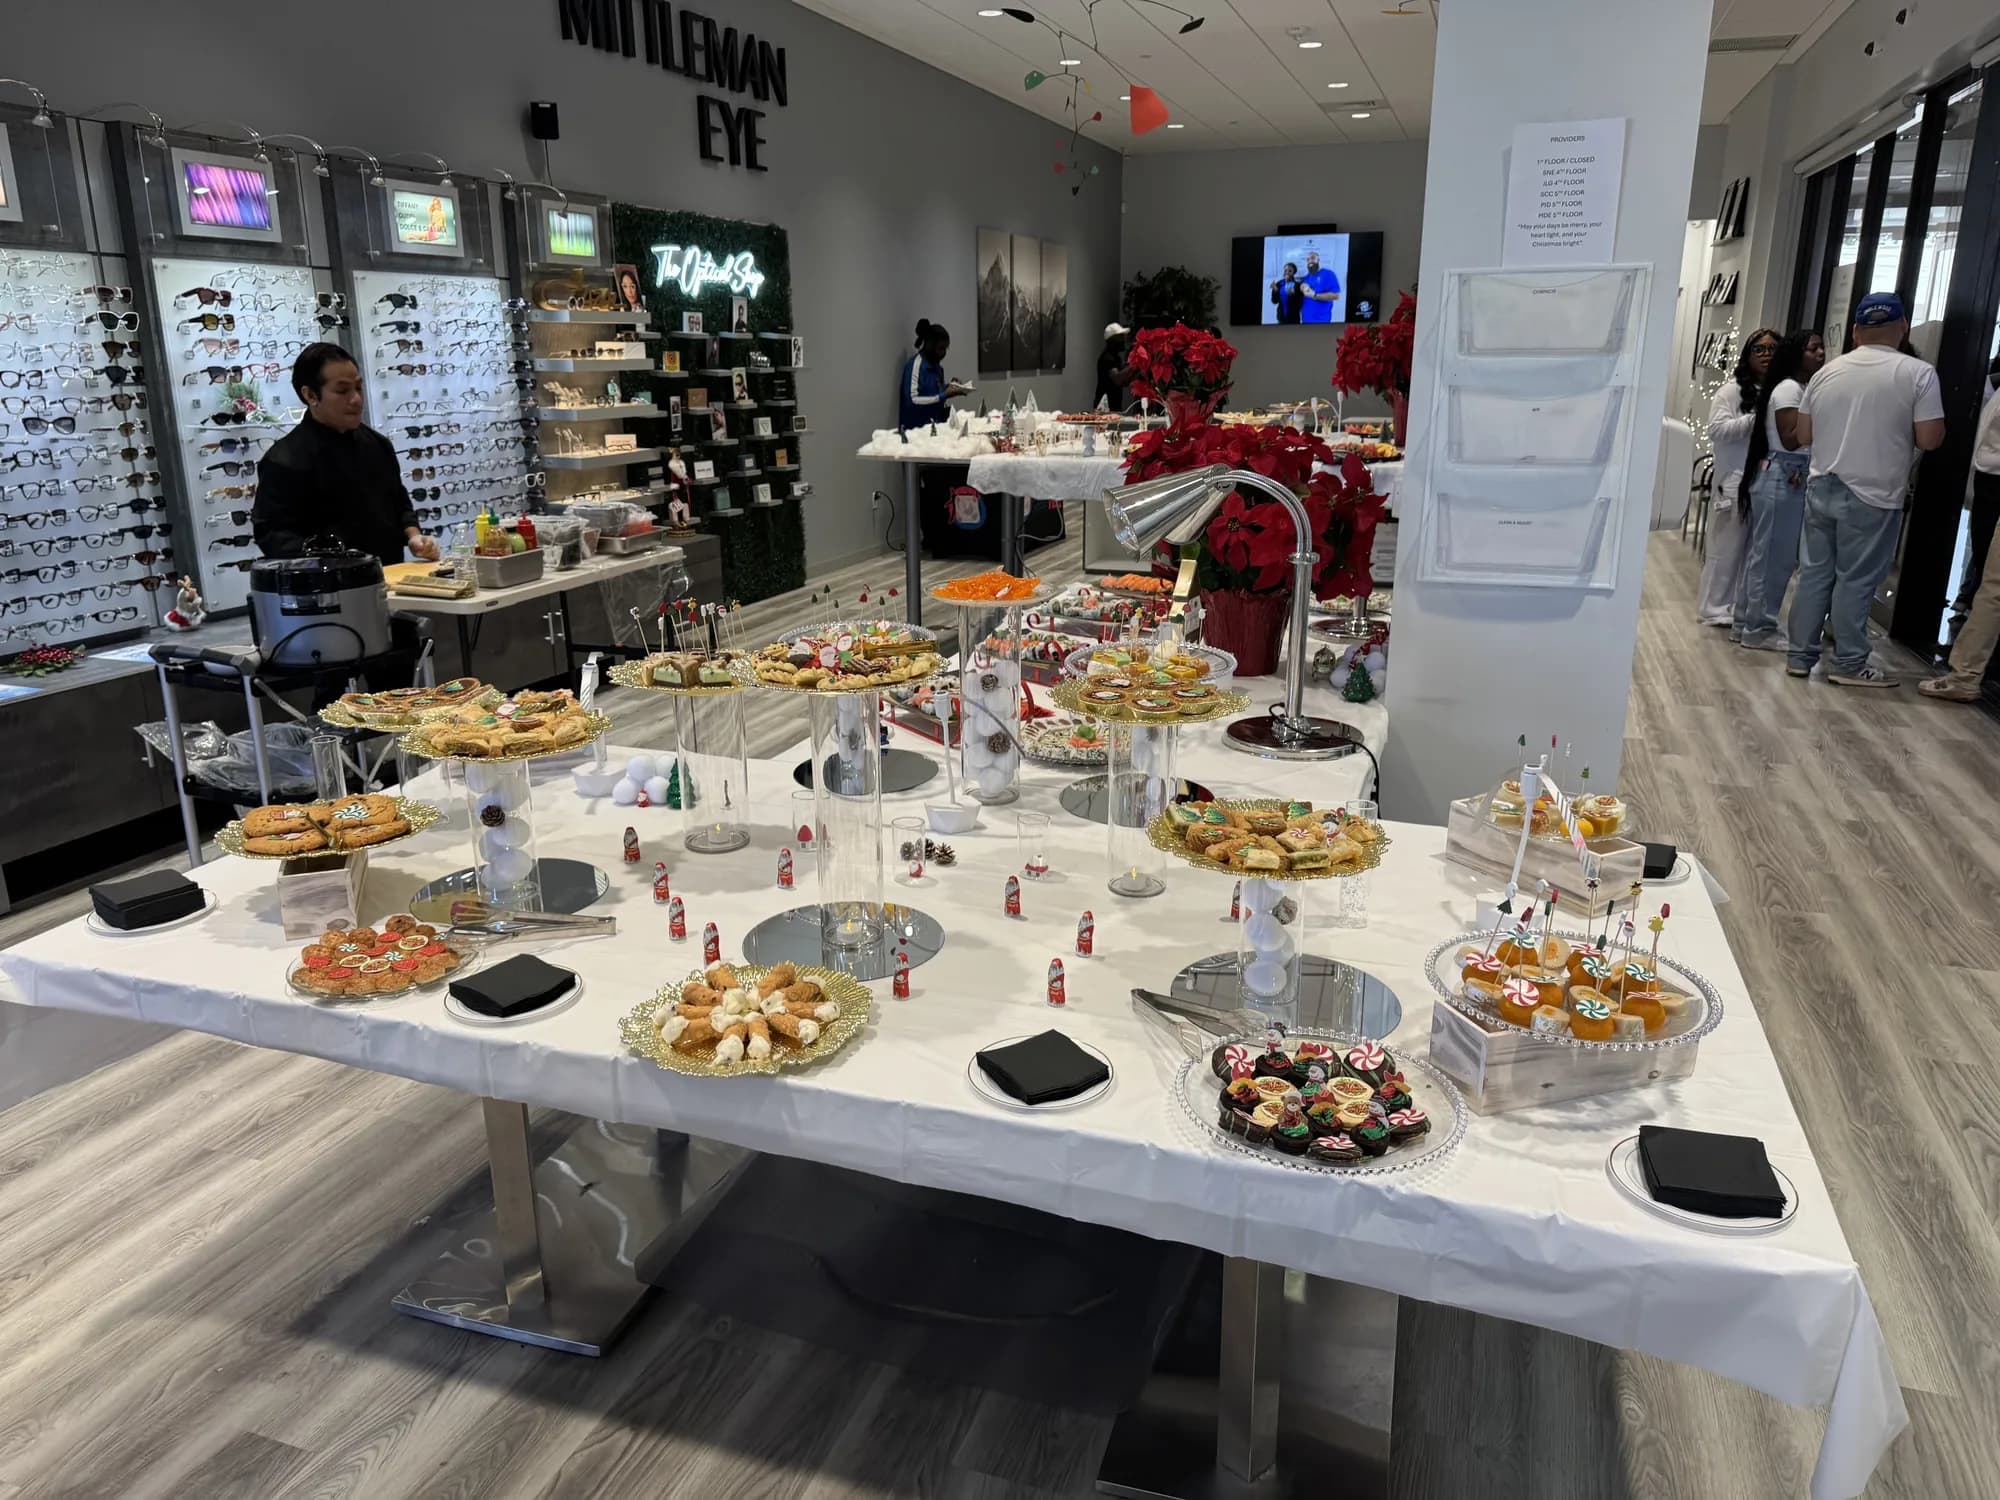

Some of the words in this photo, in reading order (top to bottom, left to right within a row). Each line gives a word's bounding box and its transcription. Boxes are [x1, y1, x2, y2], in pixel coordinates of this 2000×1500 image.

[559, 0, 787, 107] MITTLEMAN
[697, 95, 768, 172] EYE
[1550, 135, 1585, 143] PROVIDERS
[1544, 157, 1565, 165] FLOOR
[1569, 155, 1595, 164] CLOSED
[1565, 167, 1586, 175] FLOOR
[1563, 178, 1584, 186] FLOOR
[1563, 189, 1585, 197] FLOOR
[1532, 240, 1562, 248] Christmas
[651, 244, 681, 288] The
[679, 245, 735, 298] Optical
[732, 251, 765, 299] Shop
